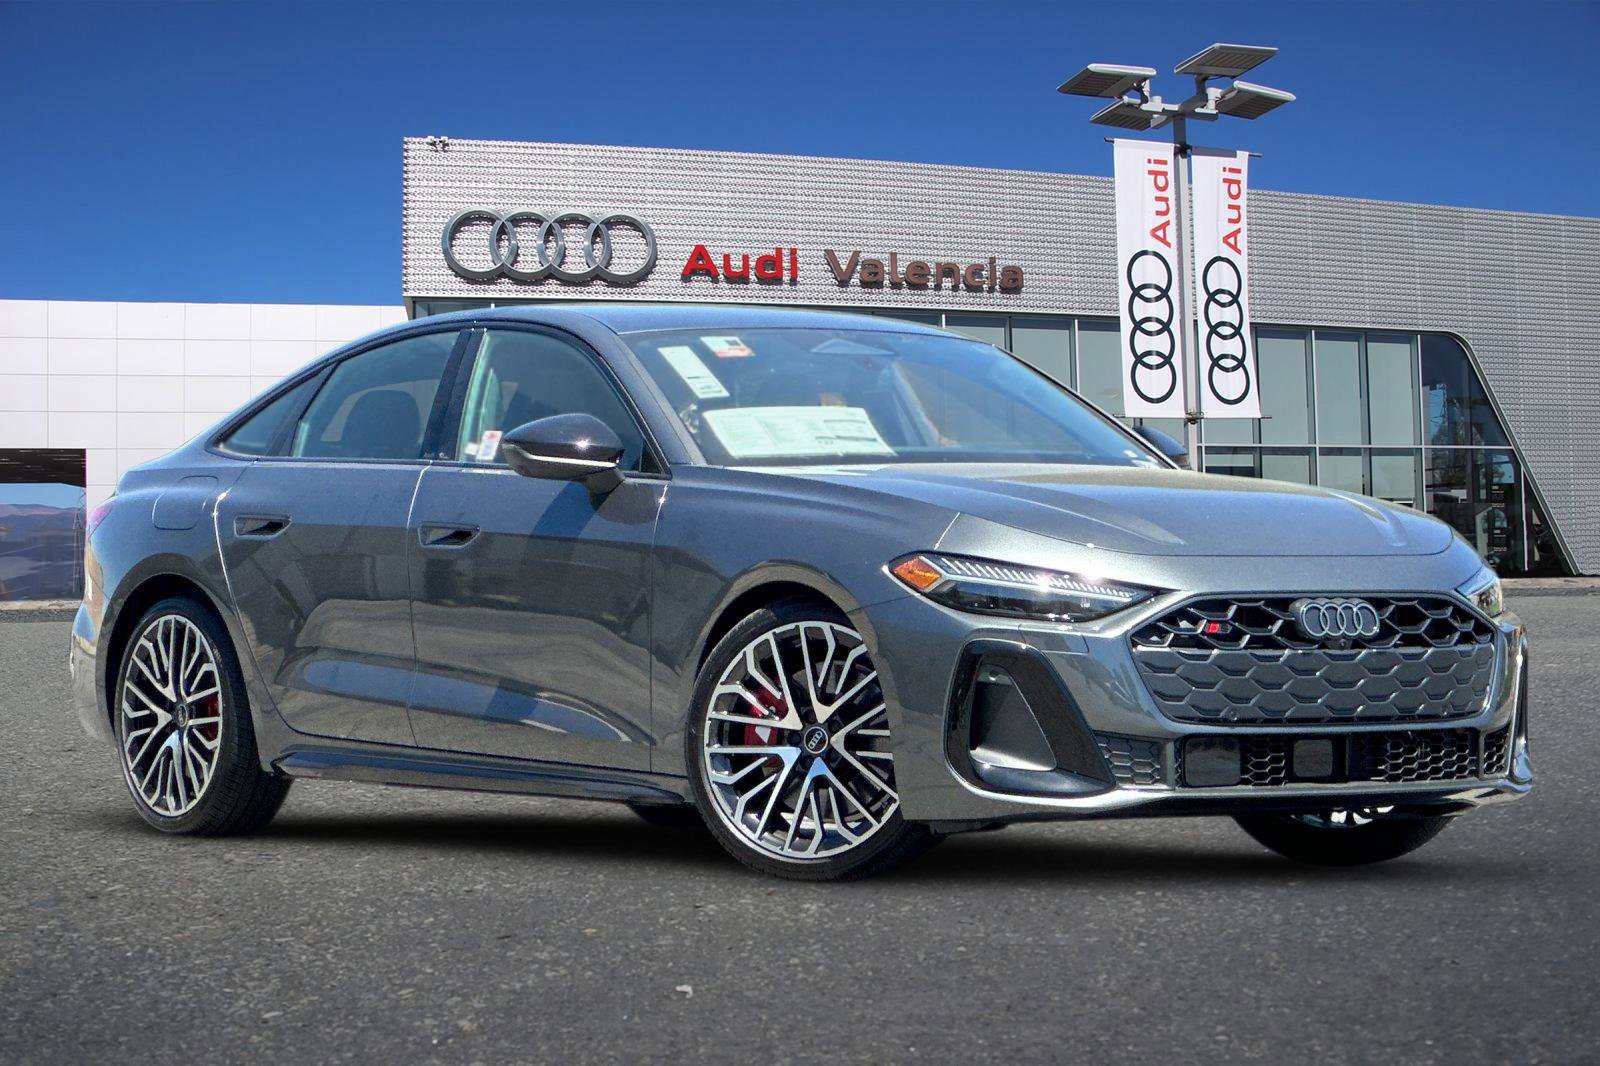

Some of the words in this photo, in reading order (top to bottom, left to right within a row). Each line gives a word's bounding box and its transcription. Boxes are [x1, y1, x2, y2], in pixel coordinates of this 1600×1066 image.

[1147, 158, 1171, 248] Audi
[1222, 166, 1242, 255] Audi
[682, 244, 799, 281] Audi
[824, 249, 1025, 289] Valencia
